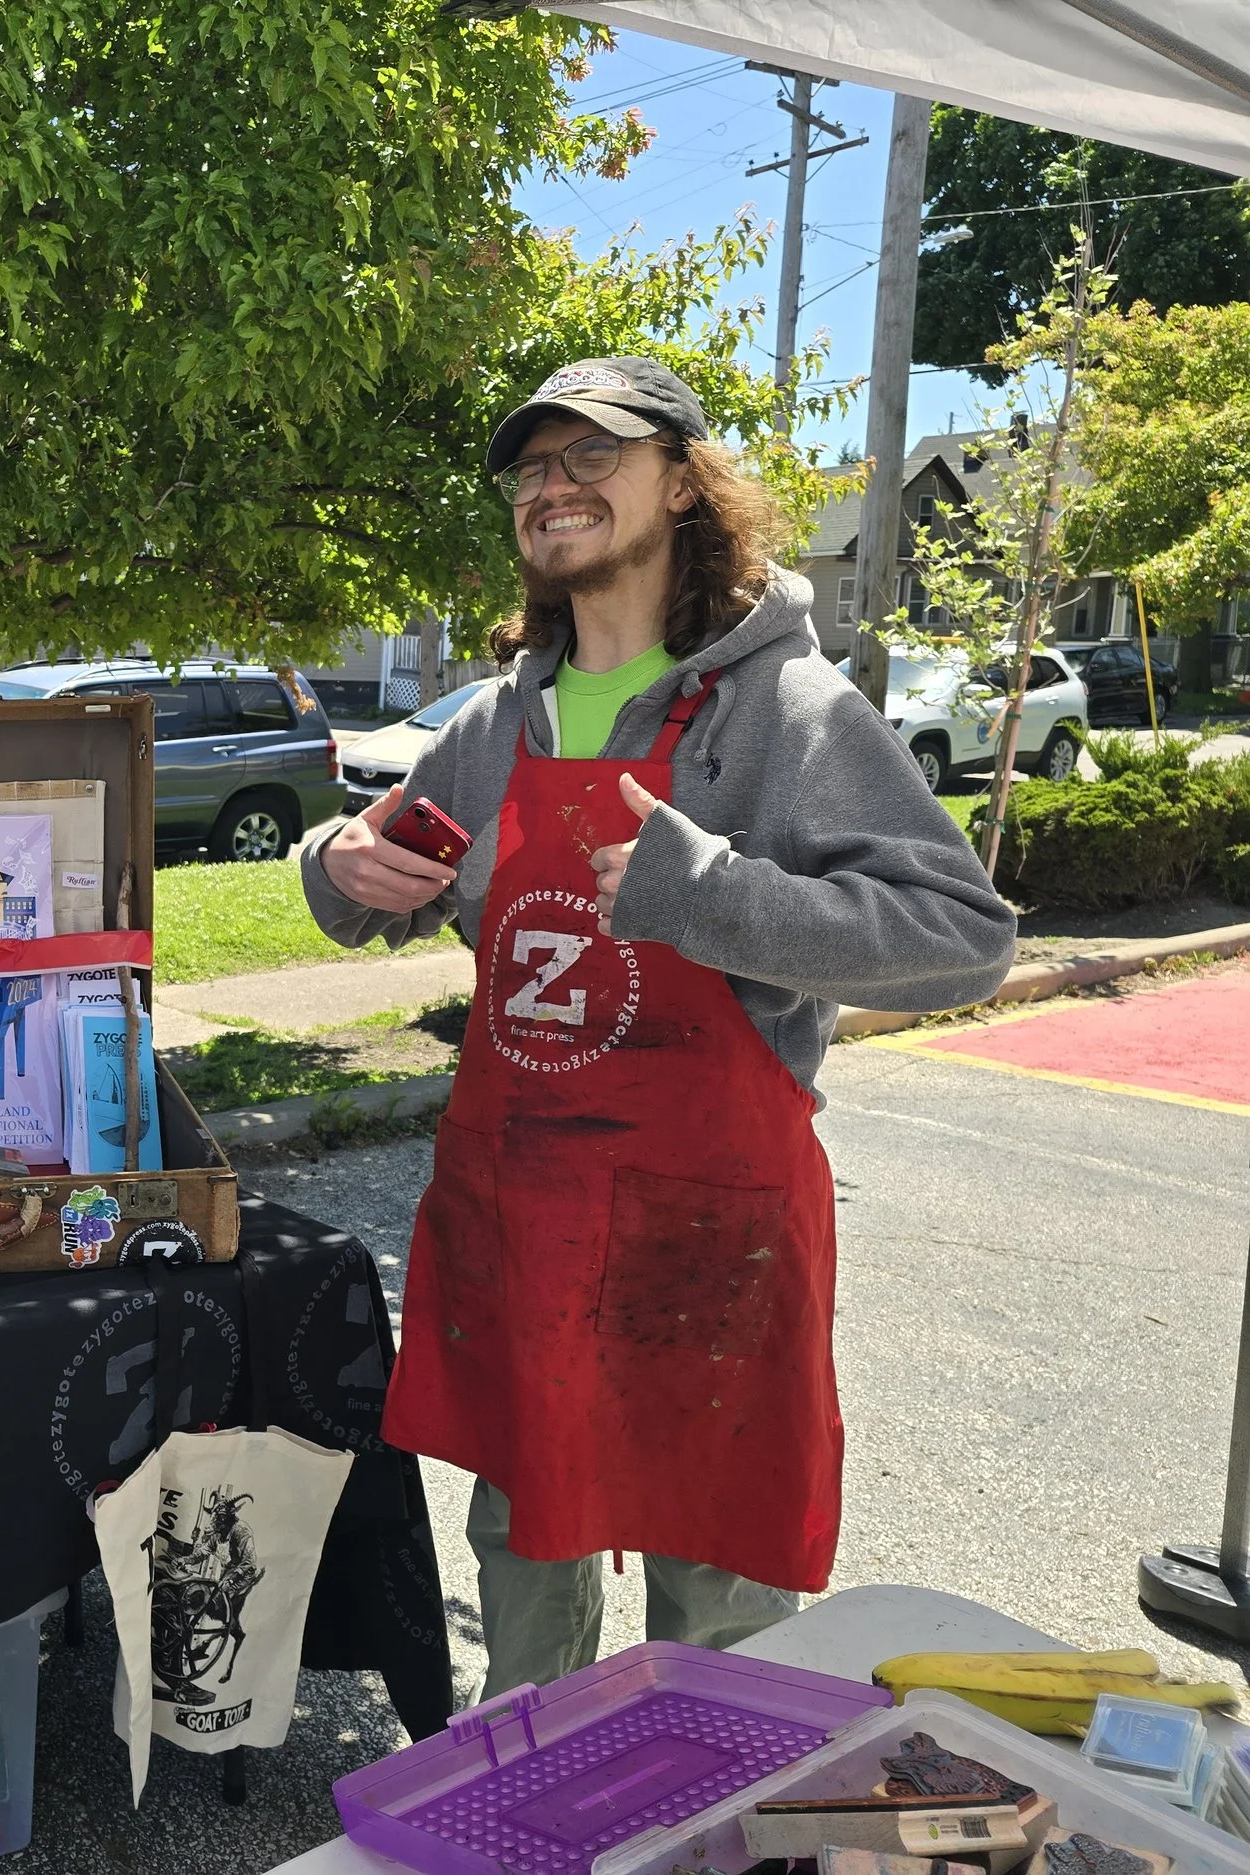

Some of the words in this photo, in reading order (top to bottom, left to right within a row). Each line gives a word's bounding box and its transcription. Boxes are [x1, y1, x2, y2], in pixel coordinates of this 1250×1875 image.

[504, 929, 593, 1026] Z
[6, 978, 38, 1006] 2024
[93, 1033, 142, 1044] ZYGOE
[510, 1024, 529, 1038] fine
[529, 1029, 545, 1040] art
[546, 1032, 575, 1043] press
[187, 1712, 220, 1732] GOAT
[224, 1703, 248, 1728] TOTE
